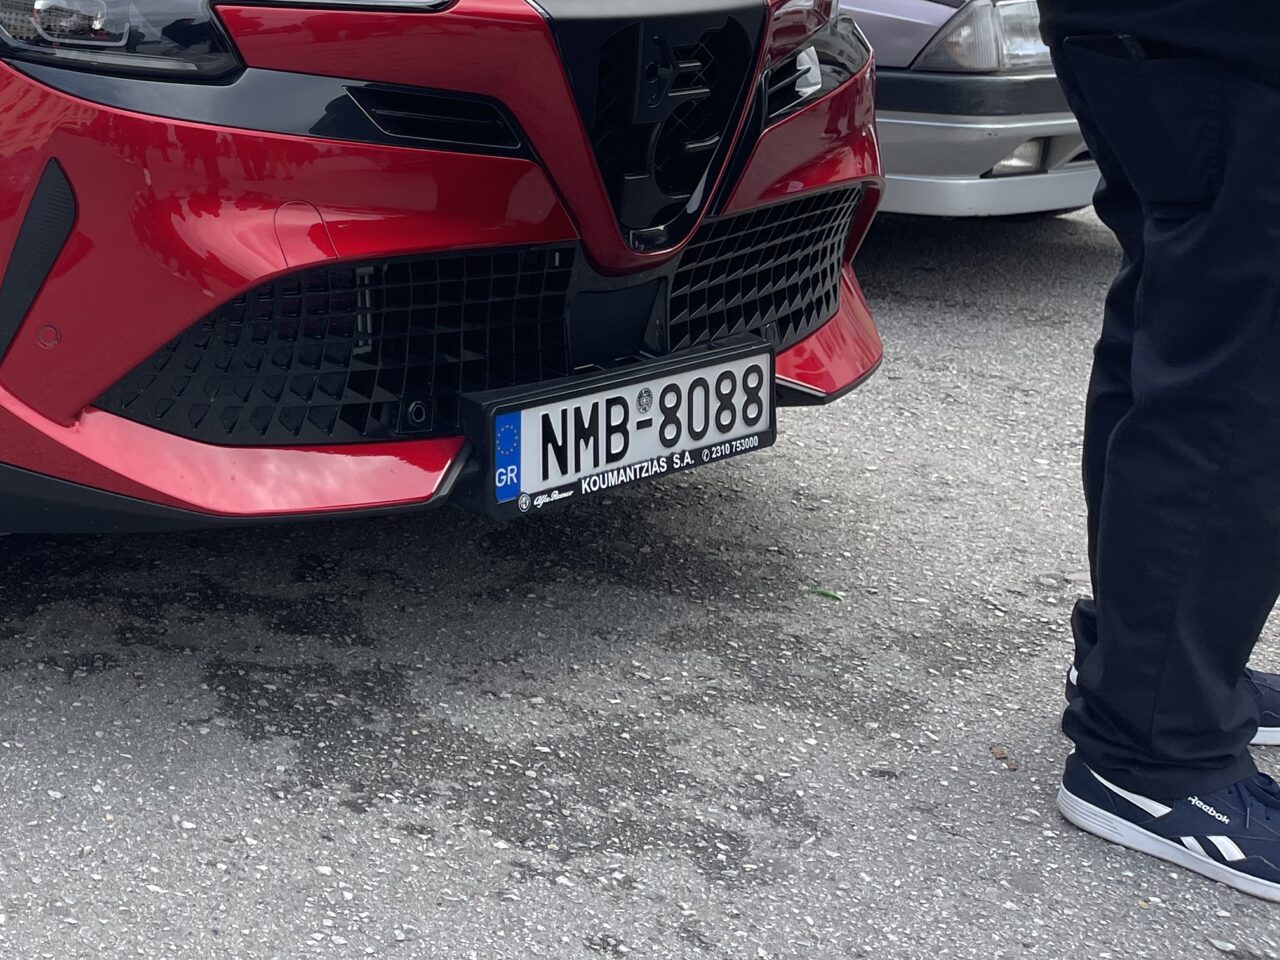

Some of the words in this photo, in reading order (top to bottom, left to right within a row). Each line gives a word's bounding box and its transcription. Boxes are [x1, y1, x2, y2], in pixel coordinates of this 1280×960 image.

[495, 465, 517, 487] GR
[581, 457, 668, 494] KOUMANTZIAS
[673, 452, 695, 469] S.A.
[711, 443, 730, 458] 2310
[731, 435, 759, 454] 753000
[1187, 796, 1231, 825] Reebok
